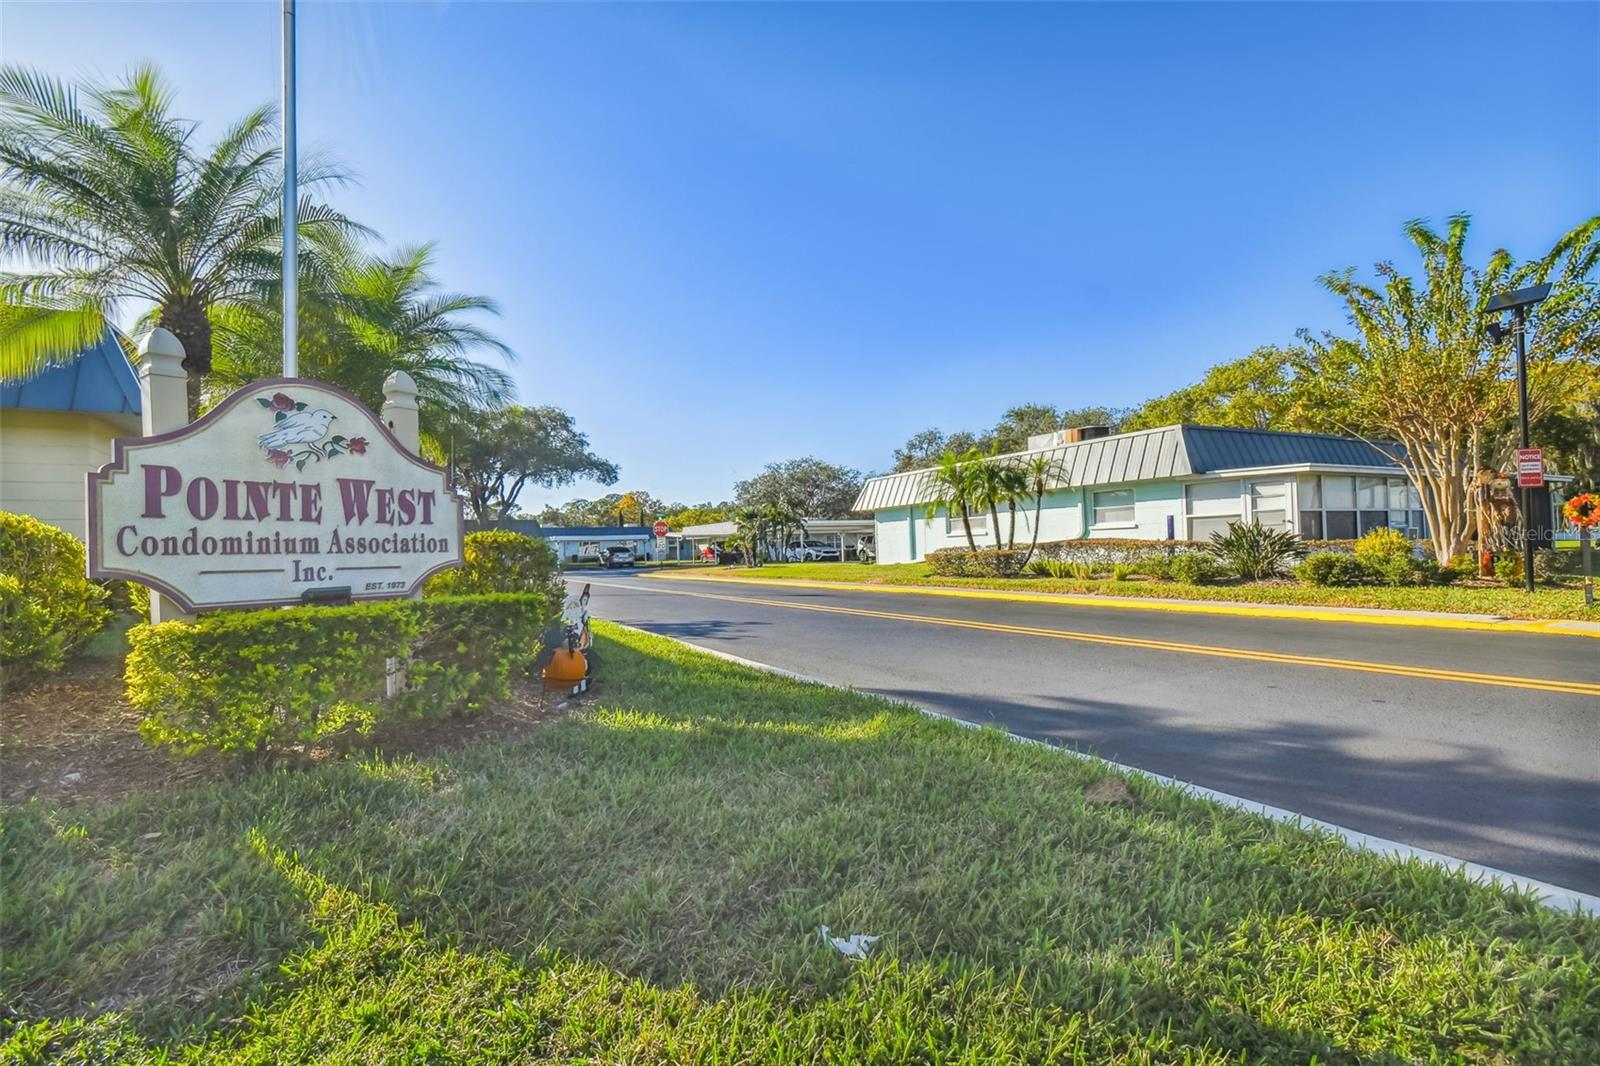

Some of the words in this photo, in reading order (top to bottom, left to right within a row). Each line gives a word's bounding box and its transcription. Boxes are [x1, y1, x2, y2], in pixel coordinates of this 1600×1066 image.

[141, 464, 322, 525] POINTE
[336, 478, 436, 526] WEST
[654, 525, 668, 533] STOP
[117, 525, 321, 557] Condominium
[326, 529, 450, 555] Association
[292, 560, 334, 583] Inc.
[365, 582, 384, 591] EST.
[387, 581, 406, 590] 1973
